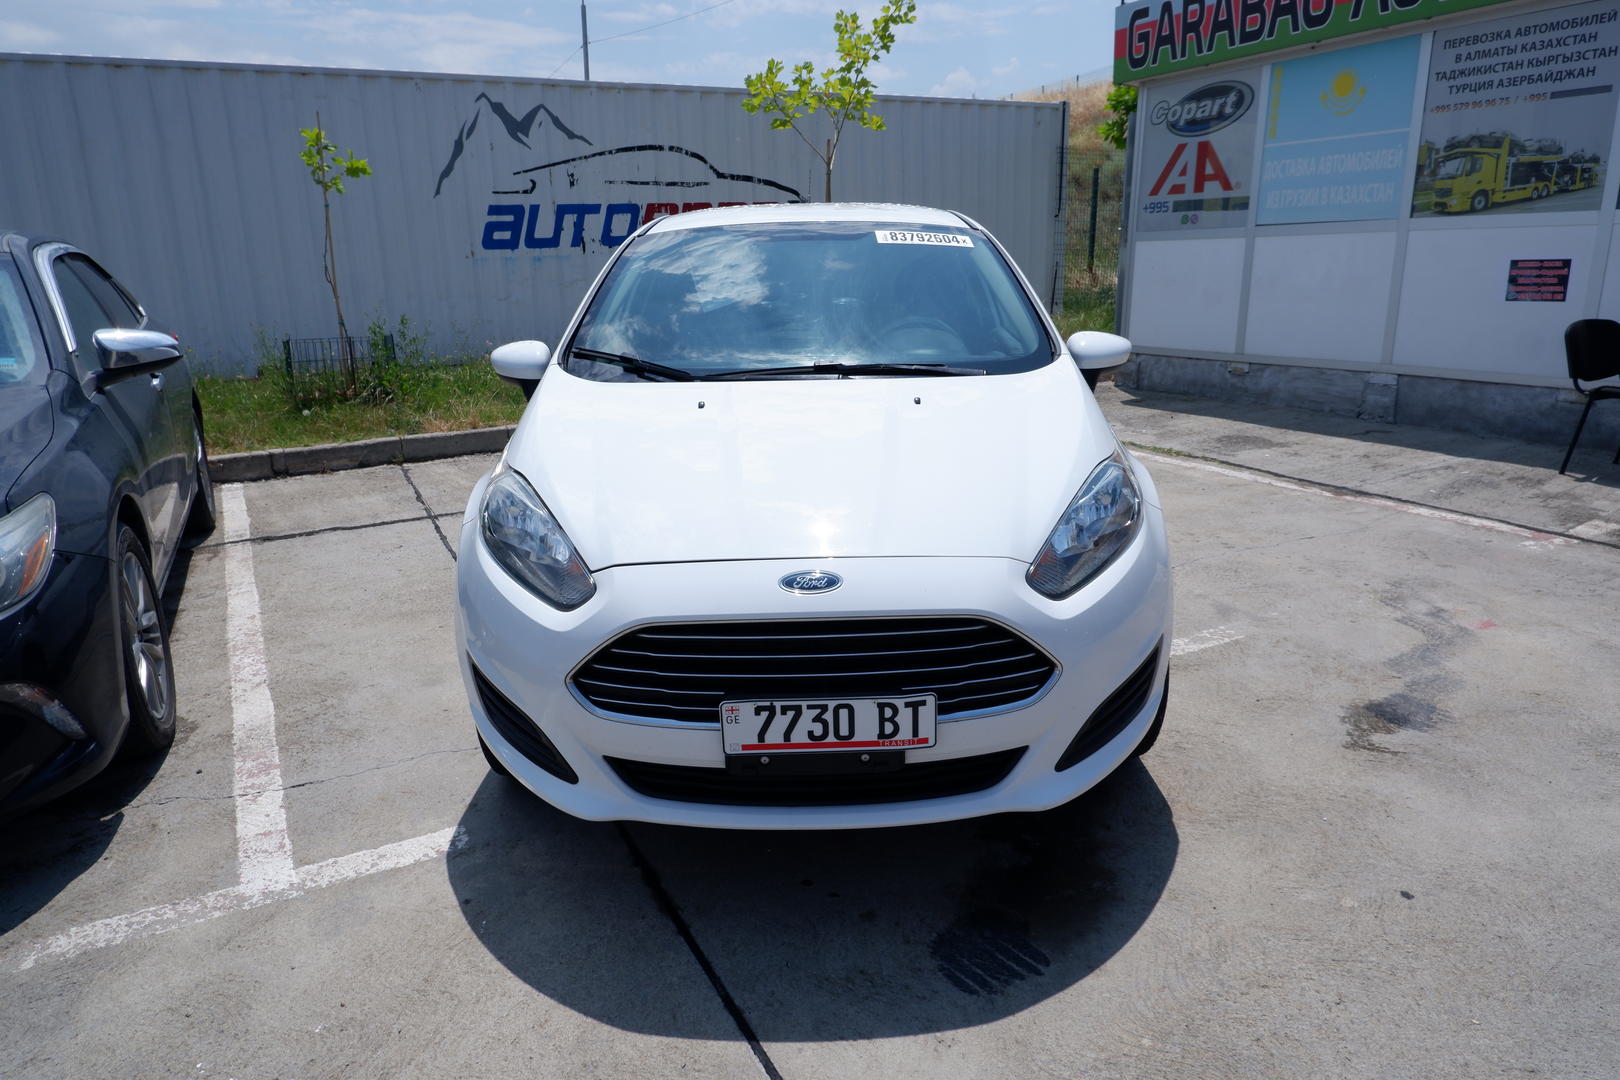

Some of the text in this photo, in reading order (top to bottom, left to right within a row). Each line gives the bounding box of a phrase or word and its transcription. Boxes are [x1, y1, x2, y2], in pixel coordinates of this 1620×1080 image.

[1443, 9, 1618, 50] ПЕРЕВОЗКА АВТОМОБИЛЕЙ
[1455, 32, 1598, 64] В АЛМАТЫ КАЗАХСТАН
[1435, 46, 1619, 82] ТАДЖИКИСТАН КЫРГЫЗСТАН
[1449, 66, 1596, 96] ТУРЦИЯ АЗЕРБАЙДЖАН
[1150, 89, 1240, 128] Copart
[1142, 200, 1169, 214] +995
[793, 576, 827, 588] Ford
[726, 715, 740, 725] GE
[754, 700, 927, 743] 7730 BT
[880, 738, 918, 747] TRANSIT
